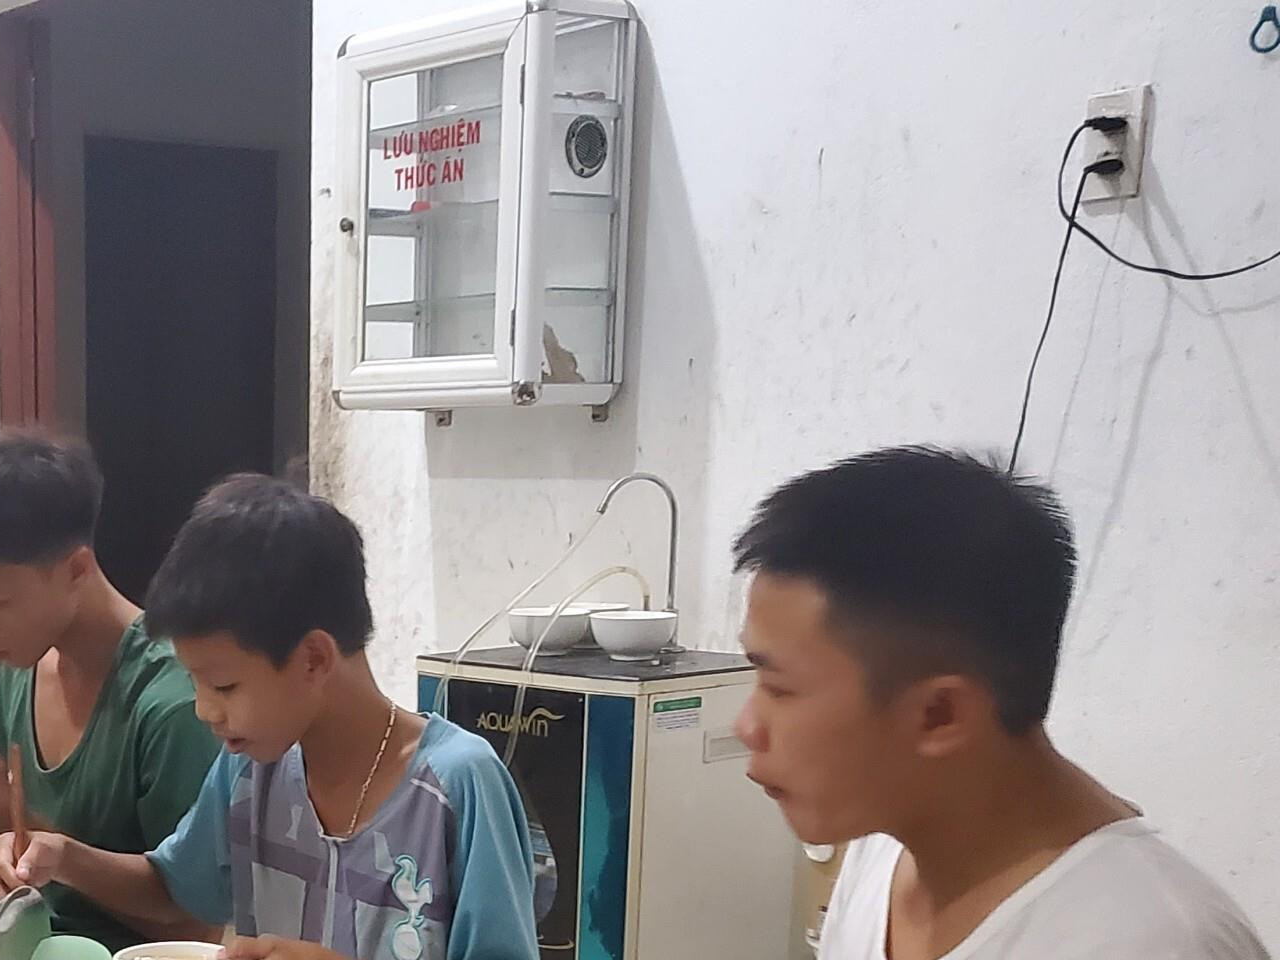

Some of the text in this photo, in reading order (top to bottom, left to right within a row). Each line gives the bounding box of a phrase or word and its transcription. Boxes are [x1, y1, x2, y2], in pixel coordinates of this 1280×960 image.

[383, 118, 481, 160] LƯU NGHIỆM
[395, 156, 465, 191] THỨC ĂN
